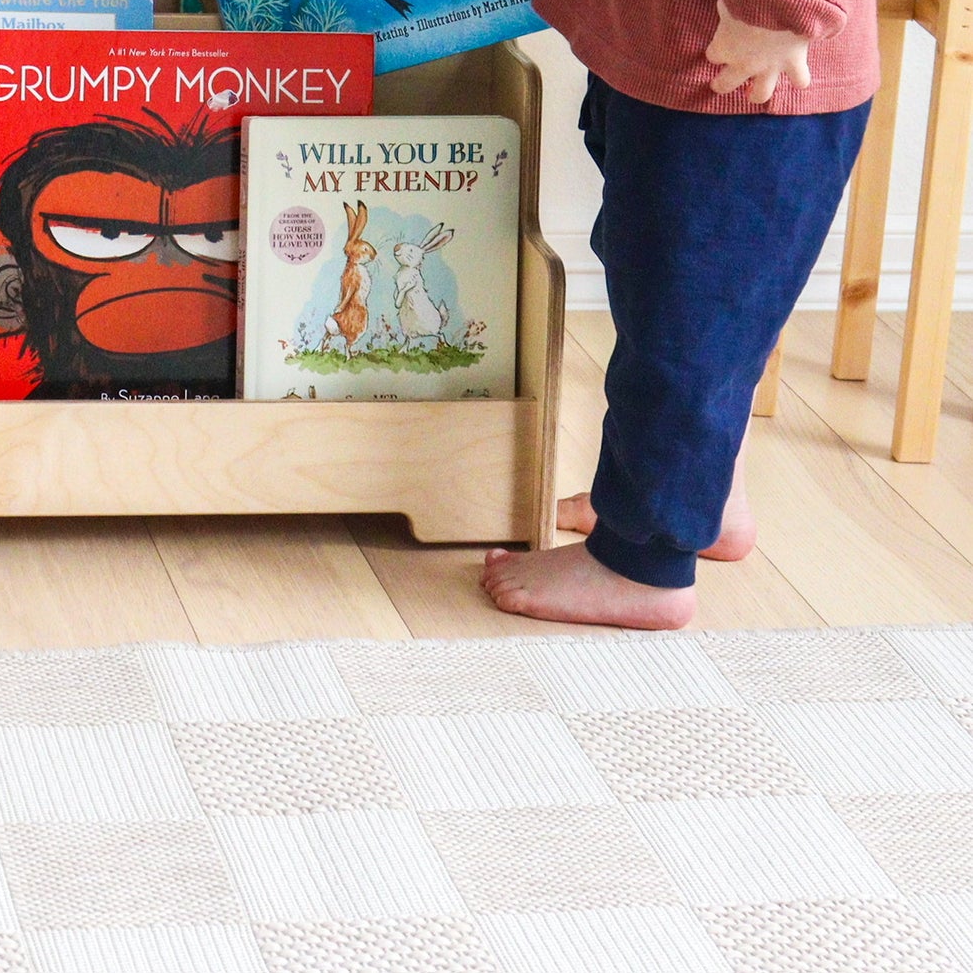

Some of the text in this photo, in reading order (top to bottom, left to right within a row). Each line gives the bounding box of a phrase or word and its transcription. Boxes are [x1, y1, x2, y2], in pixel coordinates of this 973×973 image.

[1, 16, 65, 30] Mailbox
[375, 26, 410, 43] Keating
[416, 9, 471, 32] Illustrations
[471, 4, 482, 18] by
[482, 0, 509, 14] Marta
[108, 47, 116, 56] A
[129, 48, 147, 56] New
[149, 48, 166, 57] York
[168, 48, 190, 57] Times
[191, 48, 229, 58] Bestseller
[175, 66, 351, 105] MONKEY
[298, 142, 484, 165] WILL YOU BE
[303, 170, 479, 193] MY FRIEND?
[304, 240, 323, 248] YOU
